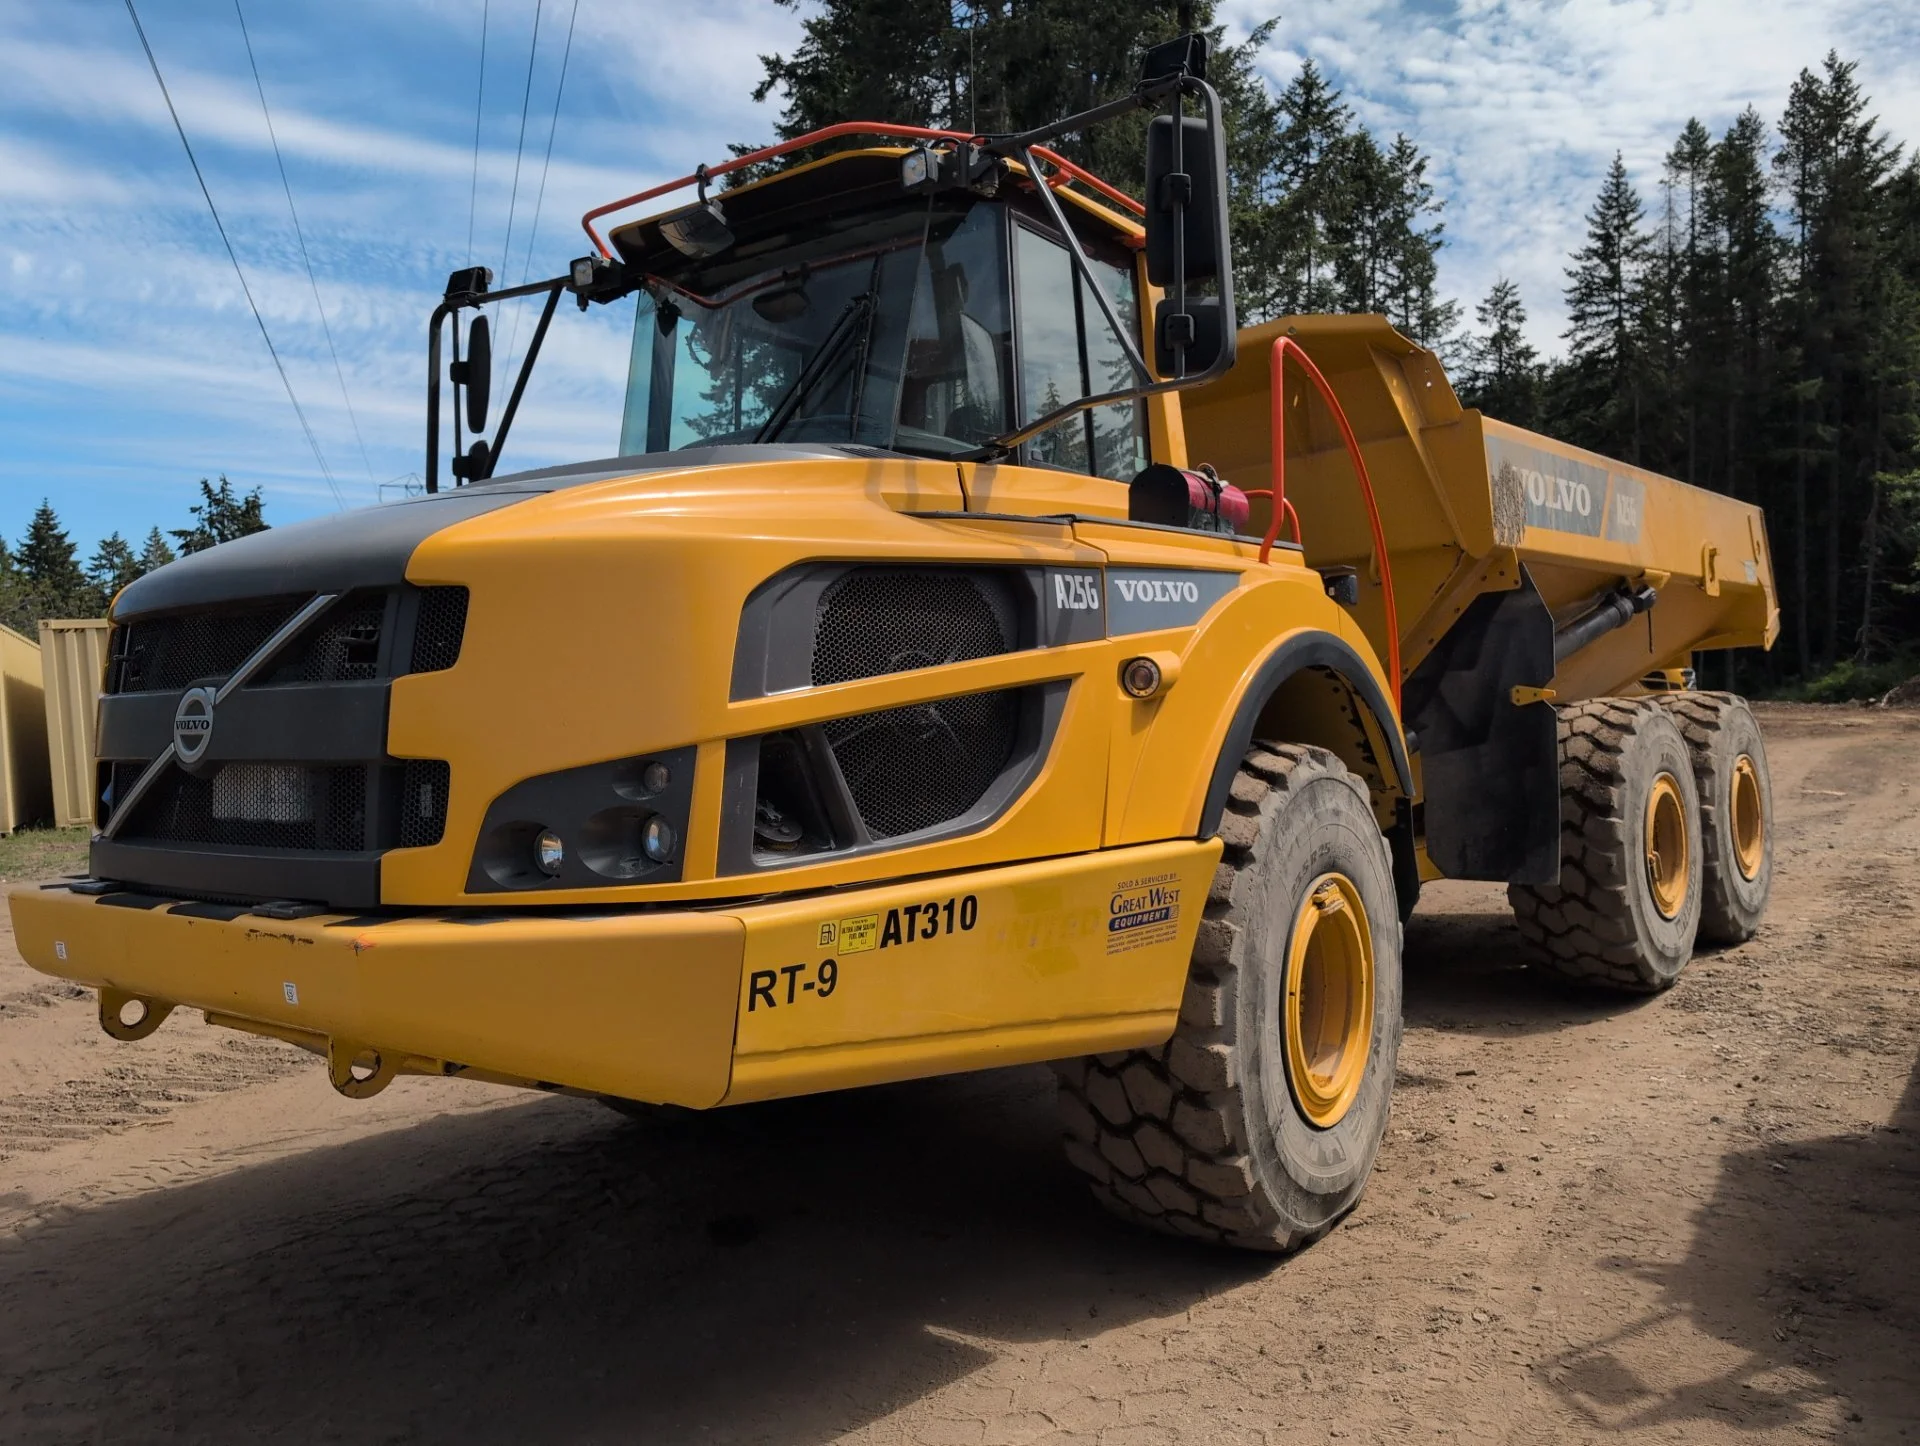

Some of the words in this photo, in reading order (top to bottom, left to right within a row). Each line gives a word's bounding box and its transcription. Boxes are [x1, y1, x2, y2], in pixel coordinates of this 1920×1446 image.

[1054, 574, 1099, 610] A25G
[1114, 579, 1199, 603] VOLVO
[175, 720, 210, 730] VOLVO
[1117, 880, 1134, 890] SOLD
[1134, 878, 1140, 887] &
[1141, 873, 1168, 886] SERVICED
[1110, 893, 1148, 915] GREAT
[1149, 886, 1181, 908] WEST
[880, 894, 978, 949] AT310
[1114, 909, 1167, 929] EQUIPMENT
[748, 958, 838, 1013] RT-9
